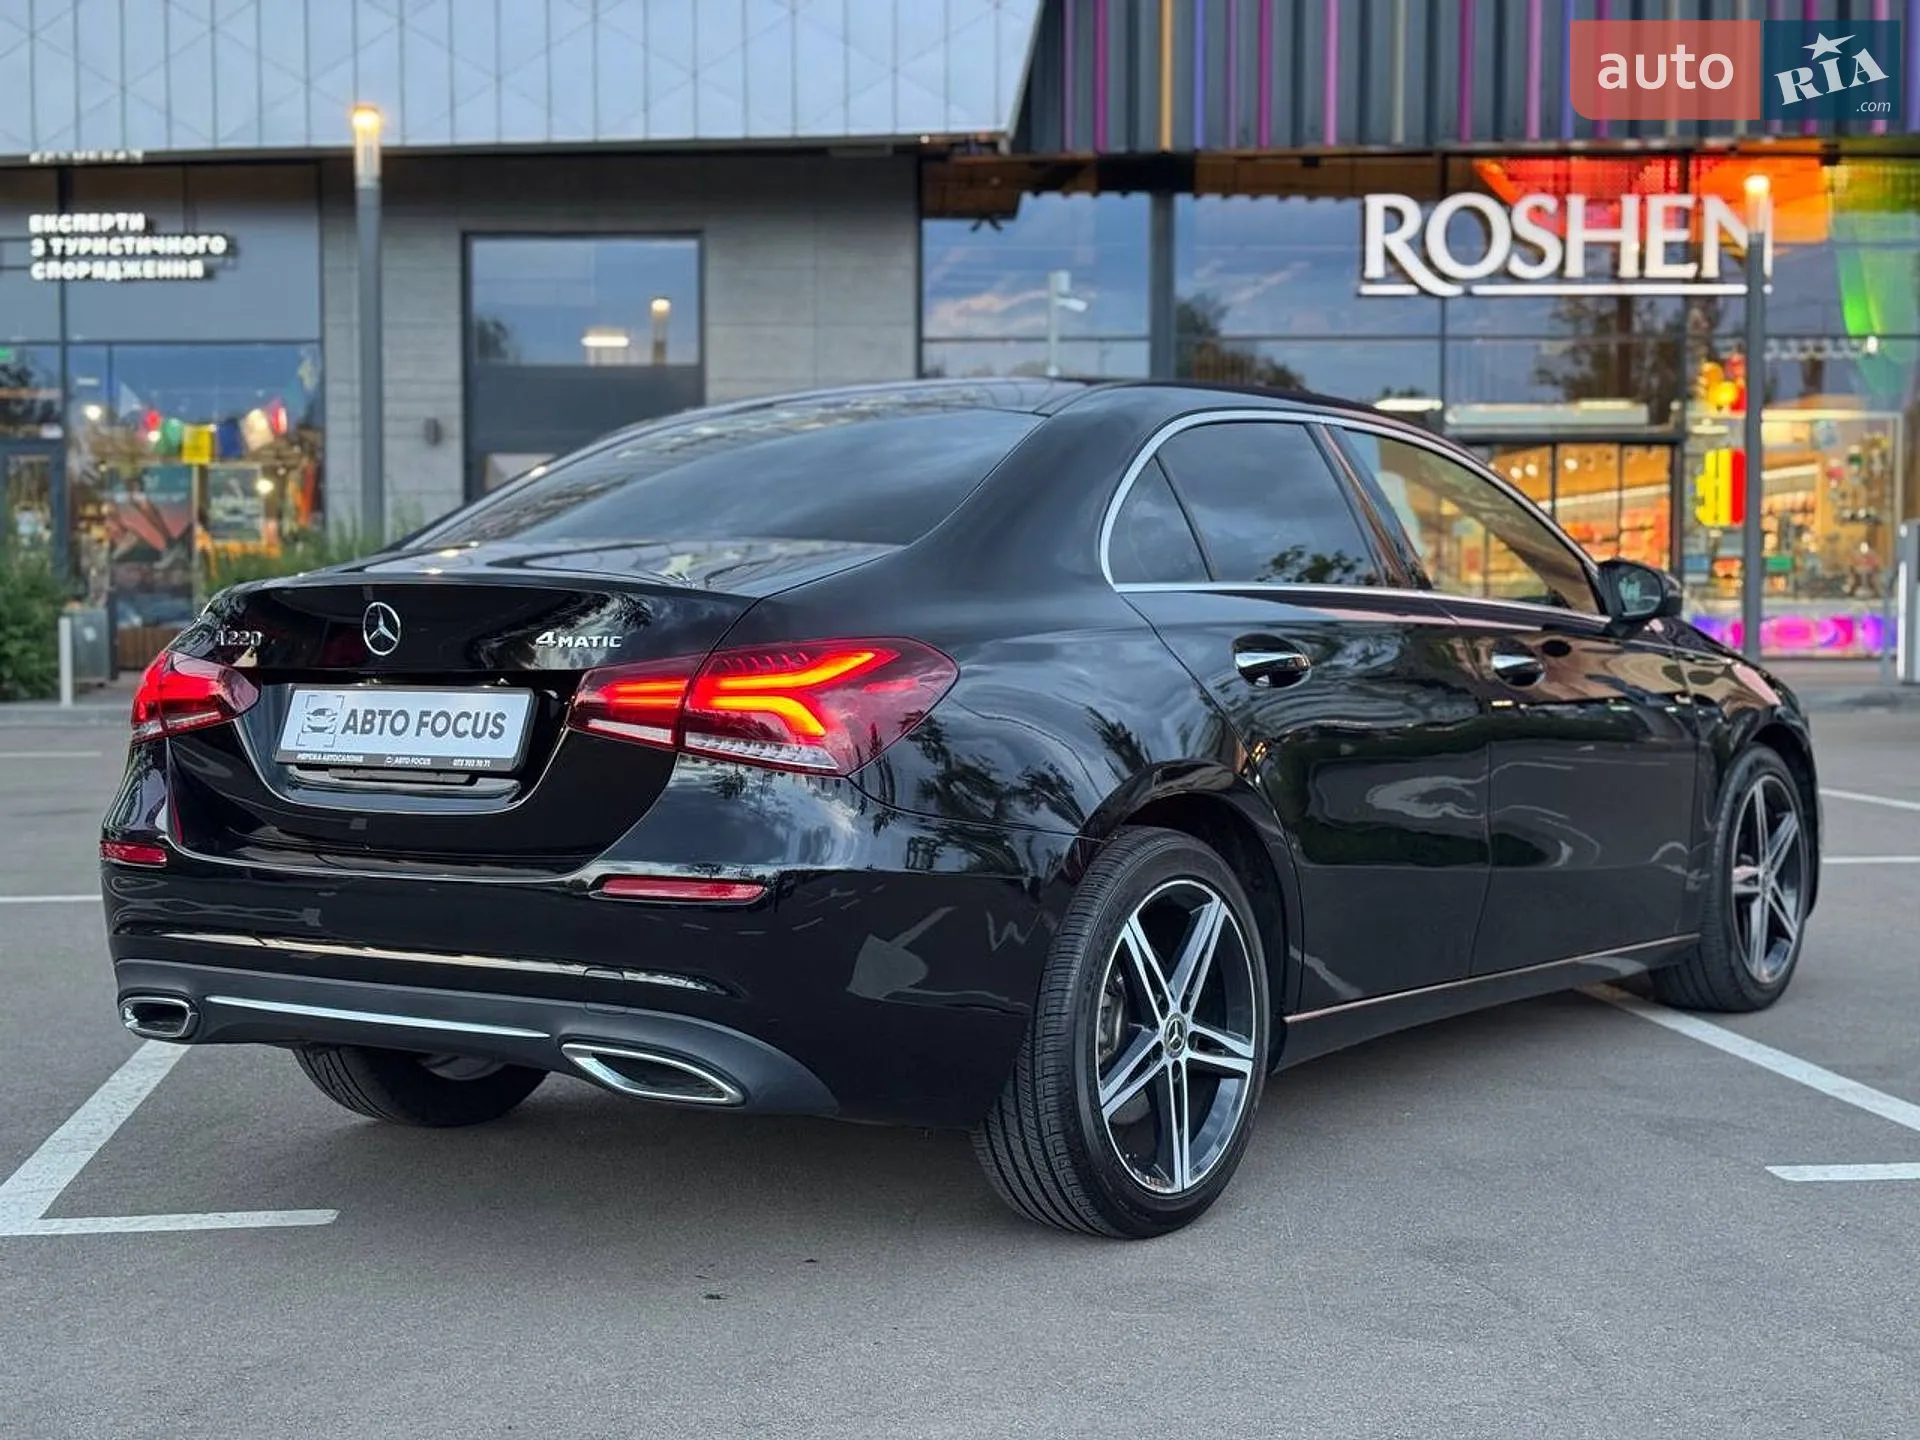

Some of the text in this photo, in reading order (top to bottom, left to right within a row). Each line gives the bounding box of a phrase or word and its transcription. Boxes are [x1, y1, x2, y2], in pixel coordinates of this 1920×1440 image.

[29, 213, 145, 233] ЕКСПЕРТИ
[50, 235, 227, 256] ТУРИСТИЧНОГО
[1362, 192, 1773, 296] ROSHEN
[31, 259, 204, 281] СПОРЯДЖЕННЯ
[535, 631, 623, 648] 4MATIC
[415, 710, 508, 740] FOCUS
